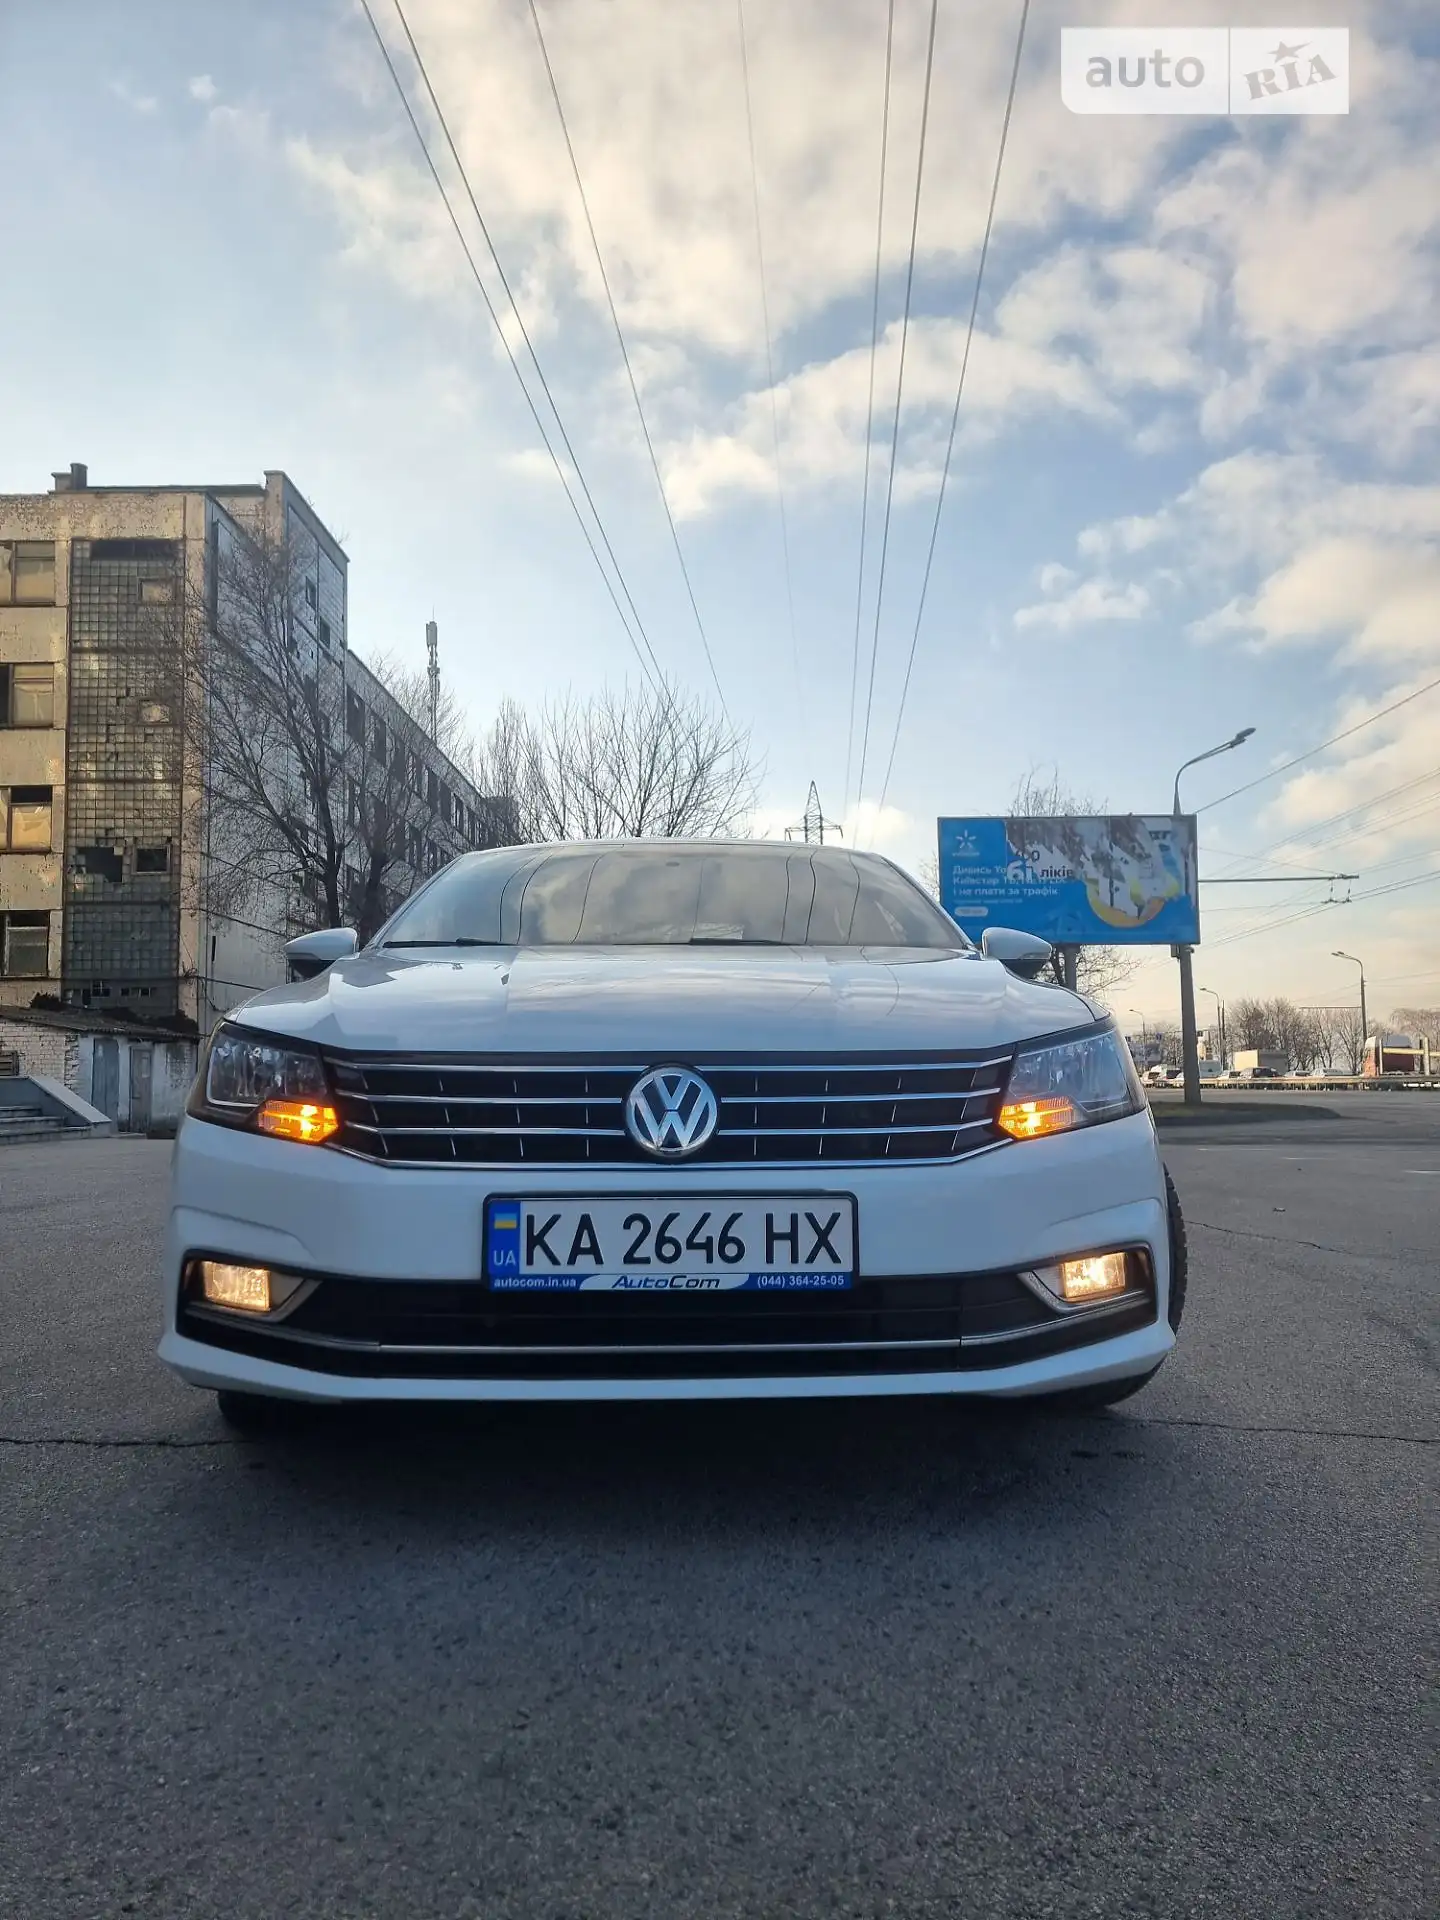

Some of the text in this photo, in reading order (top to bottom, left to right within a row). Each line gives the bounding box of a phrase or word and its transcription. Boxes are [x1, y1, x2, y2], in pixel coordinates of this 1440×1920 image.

[525, 1212, 842, 1266] KA 2646 HX
[493, 1250, 517, 1267] UA
[494, 1276, 577, 1288] autocom.in.ua
[611, 1275, 721, 1290] AutoCom
[757, 1275, 845, 1287] (044) 364-25-05
